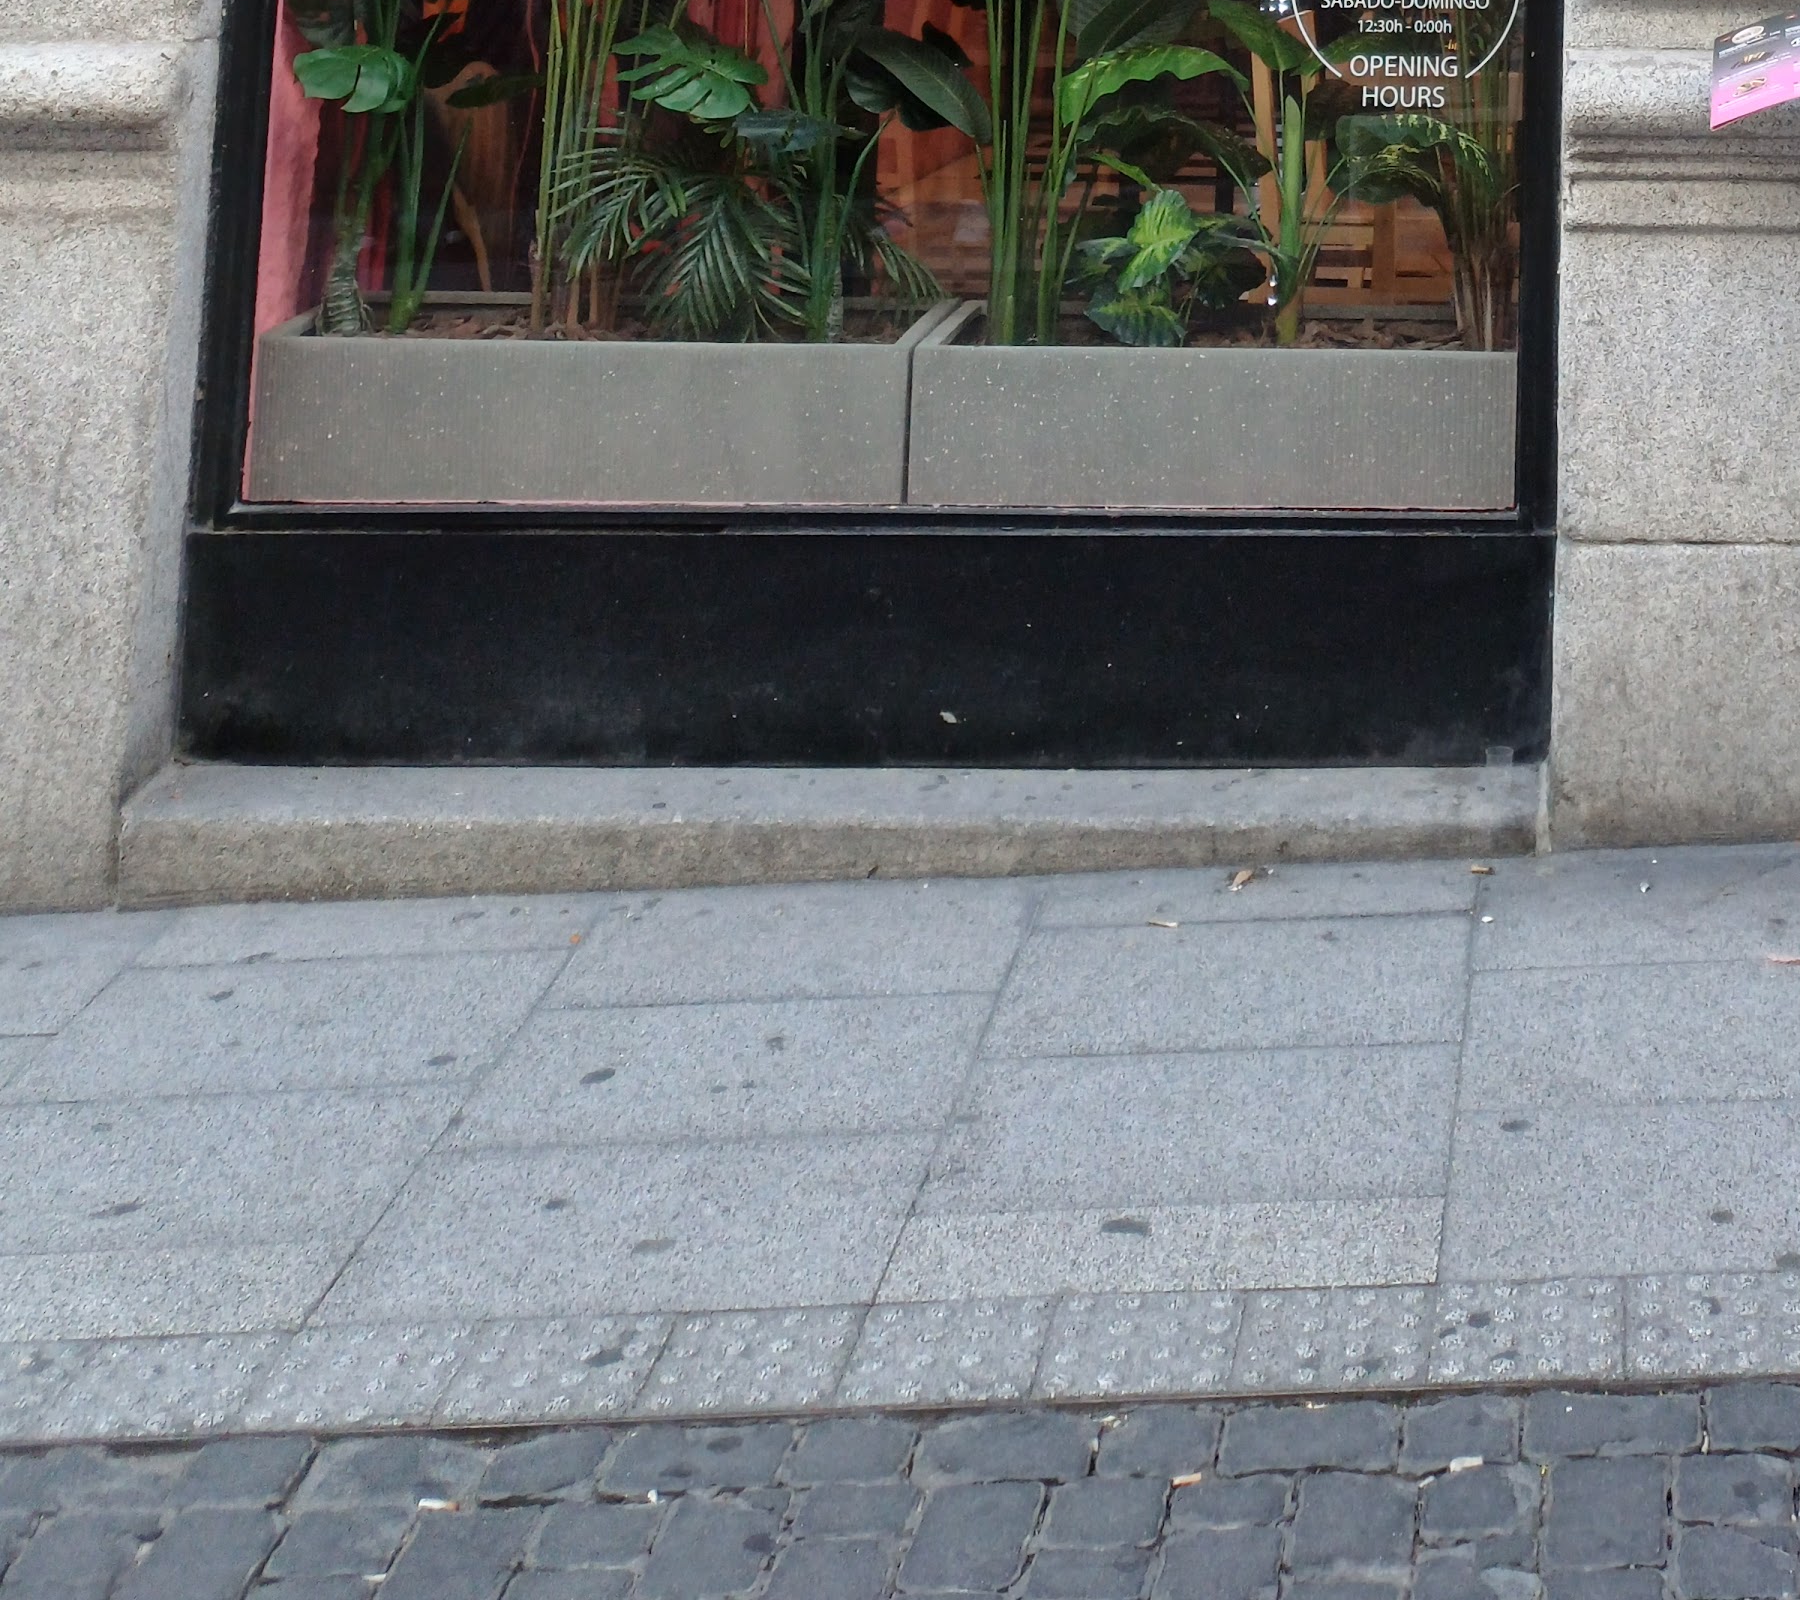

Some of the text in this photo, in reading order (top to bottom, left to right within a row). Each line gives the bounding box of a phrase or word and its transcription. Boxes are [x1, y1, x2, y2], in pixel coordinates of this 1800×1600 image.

[1357, 19, 1403, 34] 12:30h
[1414, 19, 1452, 34] 0:00h
[1349, 54, 1459, 78] OPENING
[1362, 85, 1446, 109] HOURS
